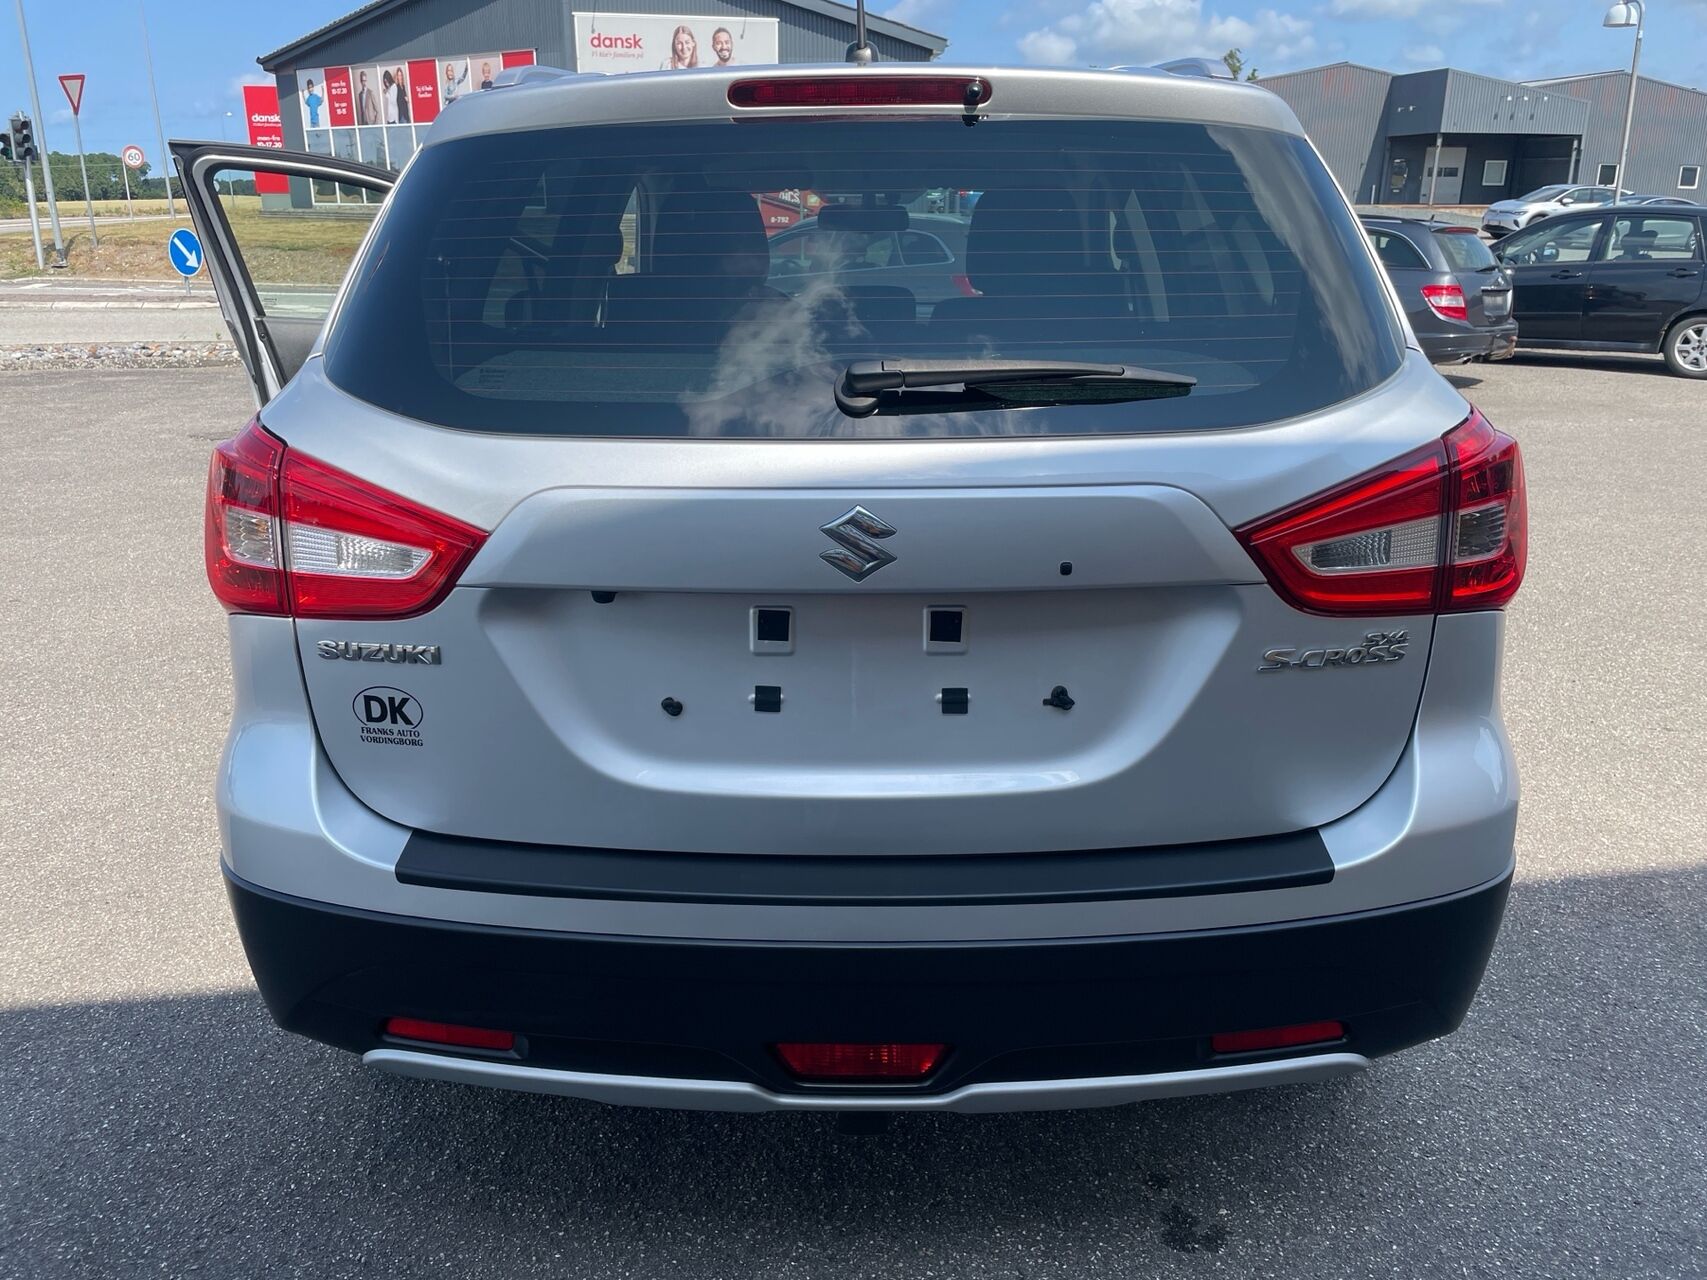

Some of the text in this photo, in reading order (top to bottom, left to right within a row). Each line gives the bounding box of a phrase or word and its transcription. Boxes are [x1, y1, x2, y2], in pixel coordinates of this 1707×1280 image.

[590, 32, 643, 49] dansk
[251, 113, 281, 123] dansk
[127, 152, 141, 161] 60
[1362, 630, 1411, 647] SX4
[317, 640, 442, 665] SUZUKI
[1257, 643, 1408, 671] S-CROSS
[363, 694, 414, 726] DK
[361, 726, 420, 738] FRANKS AUTO
[360, 735, 424, 747] VORDINGBORG
